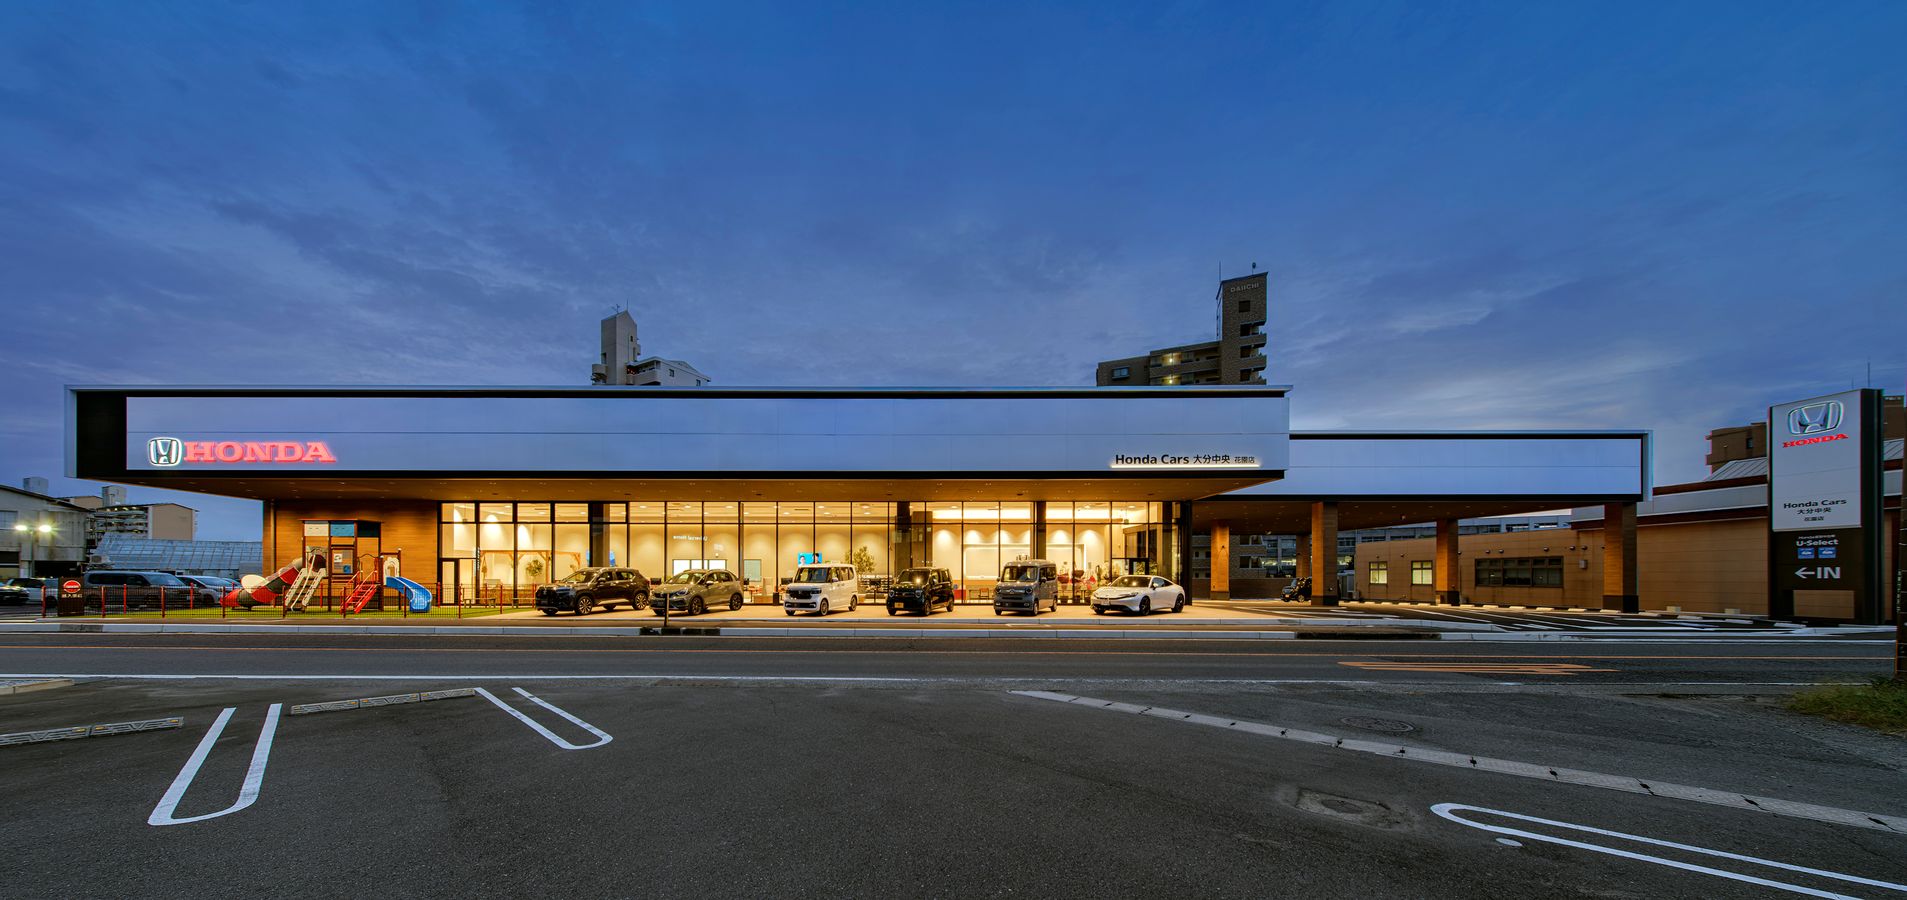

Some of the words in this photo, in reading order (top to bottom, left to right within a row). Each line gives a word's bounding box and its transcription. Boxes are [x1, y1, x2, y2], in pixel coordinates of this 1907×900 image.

[1782, 433, 1848, 448] HONDA
[183, 441, 336, 463] HONDA
[1115, 454, 1158, 465] Honda
[1160, 454, 1190, 465] Cars
[1193, 454, 1230, 464] 大分中央
[1783, 501, 1818, 509] Honda
[1797, 507, 1832, 515] 大分中央
[1796, 539, 1839, 547] U-Select
[1816, 566, 1841, 579] IN
